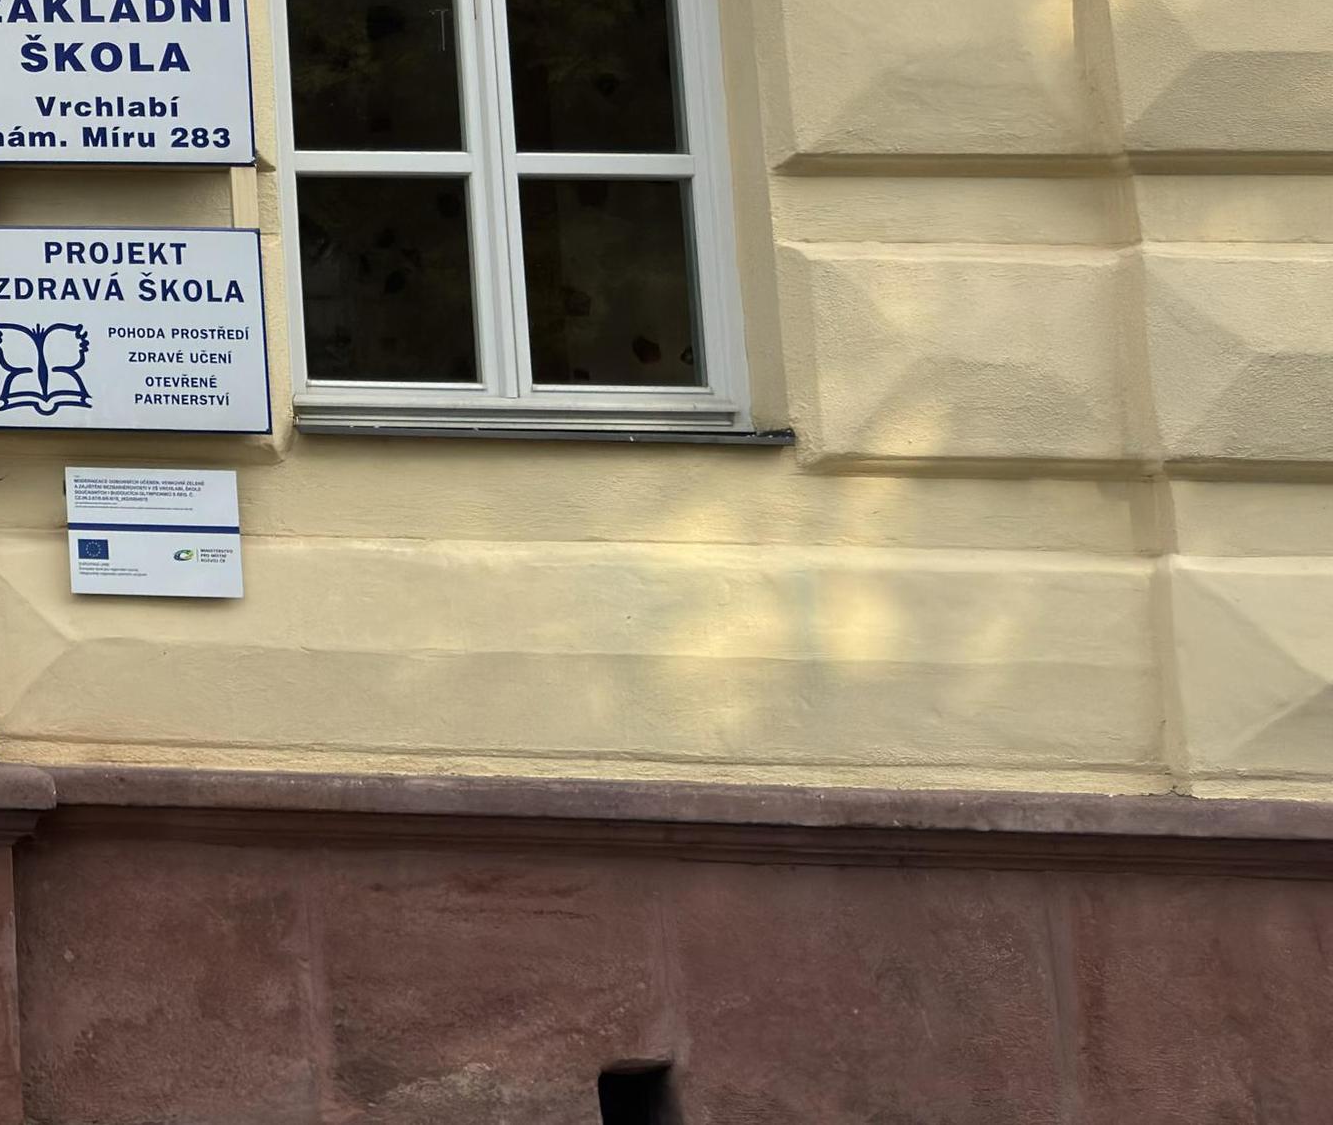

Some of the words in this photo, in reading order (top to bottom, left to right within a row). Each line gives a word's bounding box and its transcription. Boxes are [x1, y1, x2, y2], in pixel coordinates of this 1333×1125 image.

[21, 35, 190, 72] ŠKOLA
[35, 96, 179, 117] Vrchlabí
[83, 127, 155, 147] Míru
[171, 127, 230, 148] 283
[45, 242, 186, 265] PROJEKT
[139, 272, 244, 302] ŠKOLA
[109, 327, 165, 338] POHODA
[172, 326, 248, 340] PROSTŘEDÍ
[129, 350, 183, 363] ZDRAVÉ
[190, 350, 231, 363] UČENÍ
[146, 374, 217, 388] OTEVŘENÉ
[135, 394, 229, 405] PARTNERSTVÍ
